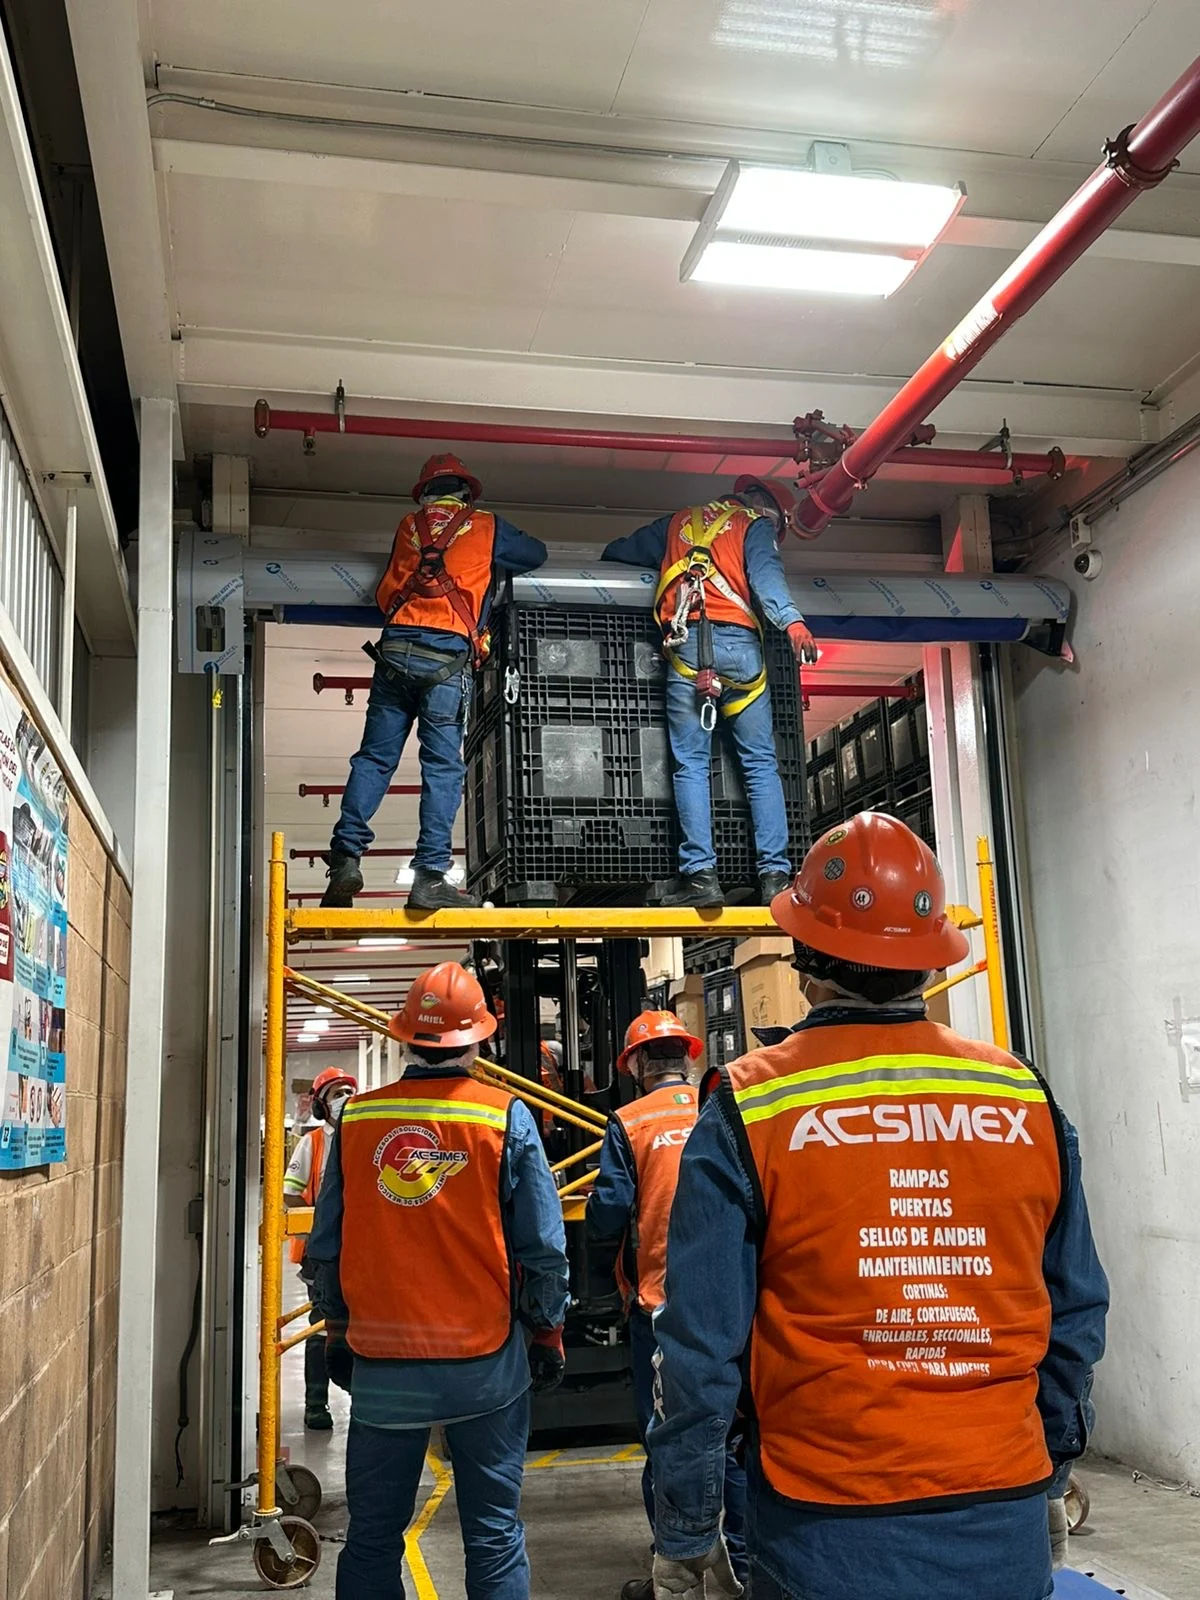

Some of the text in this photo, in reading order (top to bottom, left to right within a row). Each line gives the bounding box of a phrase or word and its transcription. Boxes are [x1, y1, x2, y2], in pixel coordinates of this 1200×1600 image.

[418, 1014, 445, 1025] ARIEL
[788, 1103, 1034, 1152] ACSIMEX
[889, 1169, 949, 1188] RAMPAS
[889, 1198, 953, 1217] PUERTAS
[859, 1227, 987, 1247] SELLOS DE ANDEN
[858, 1256, 993, 1277] MANTENIMIENTOS
[902, 1283, 949, 1300] CORTINAS:
[876, 1306, 980, 1326] DE AIRE, CORTAFUEGOS,
[862, 1327, 993, 1346] ENROLLABLES, SECCIONALES,
[905, 1346, 946, 1360] RAPIDAS
